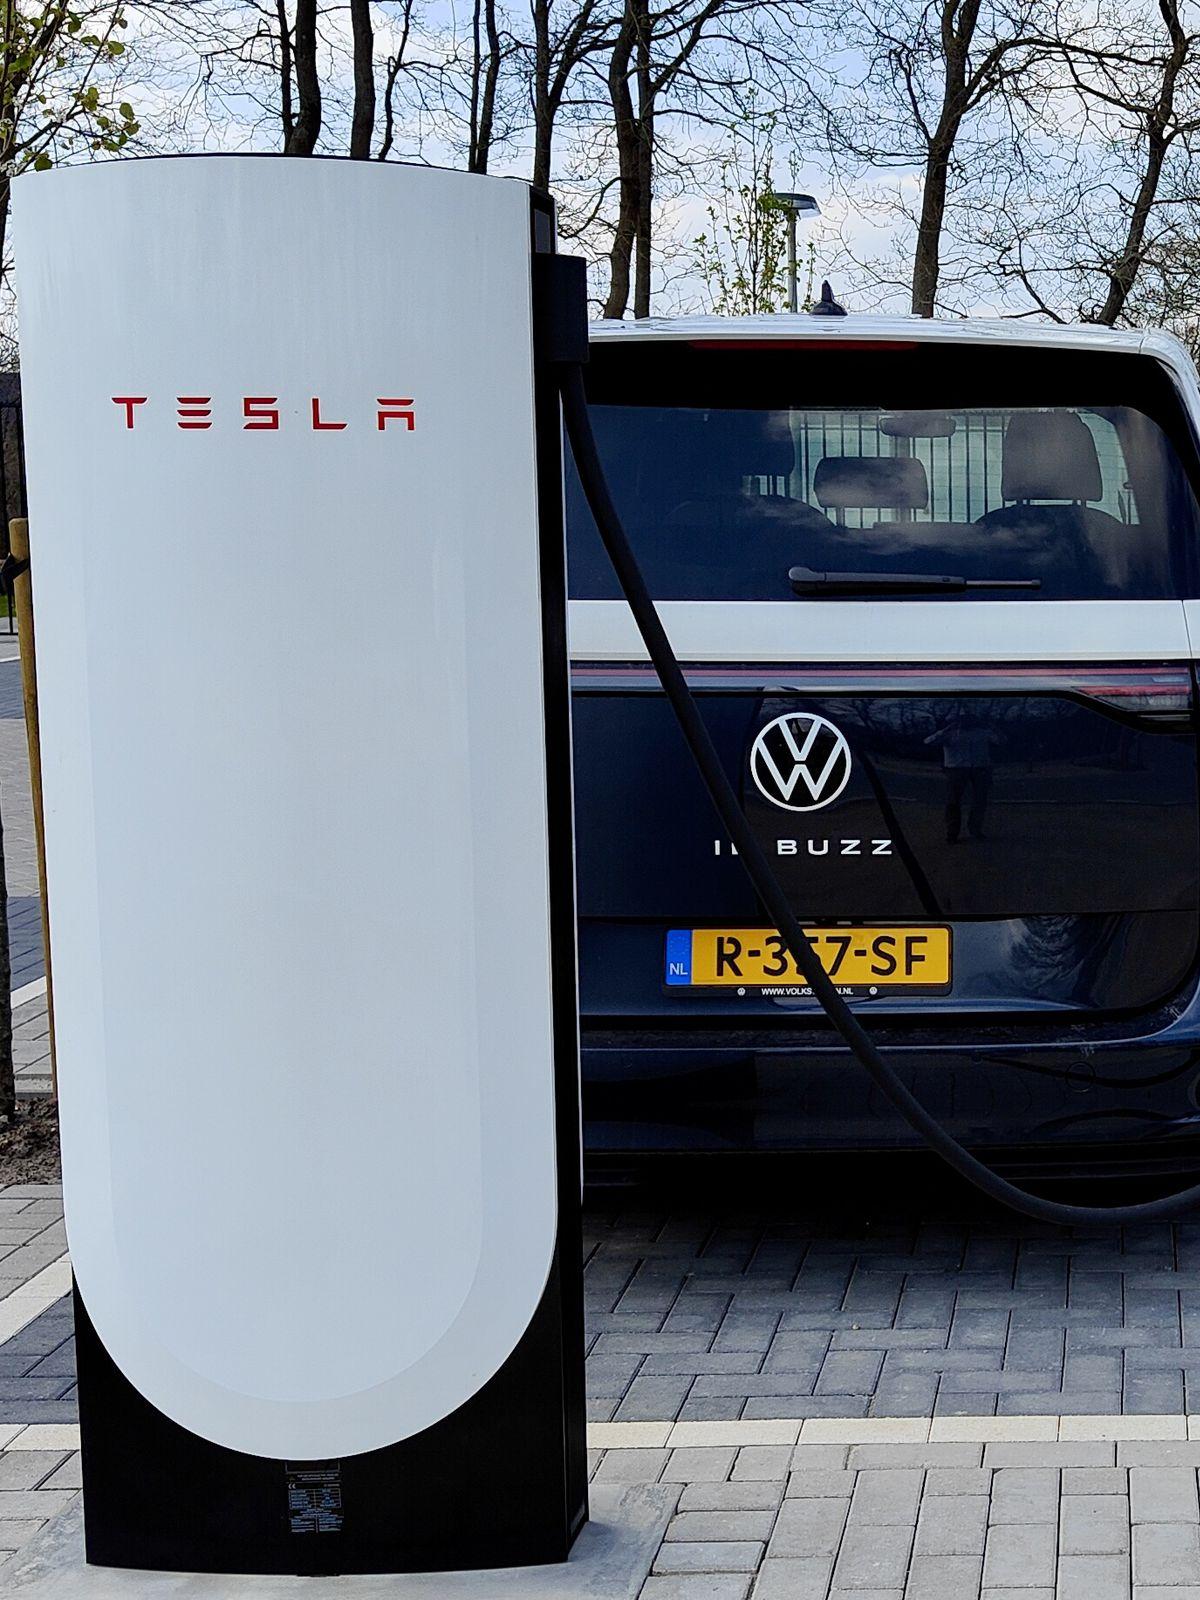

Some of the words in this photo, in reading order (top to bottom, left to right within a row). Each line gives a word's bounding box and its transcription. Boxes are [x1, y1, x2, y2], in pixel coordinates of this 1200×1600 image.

[111, 396, 415, 431] TESLA
[777, 839, 892, 855] BUZZ
[669, 963, 689, 976] NL
